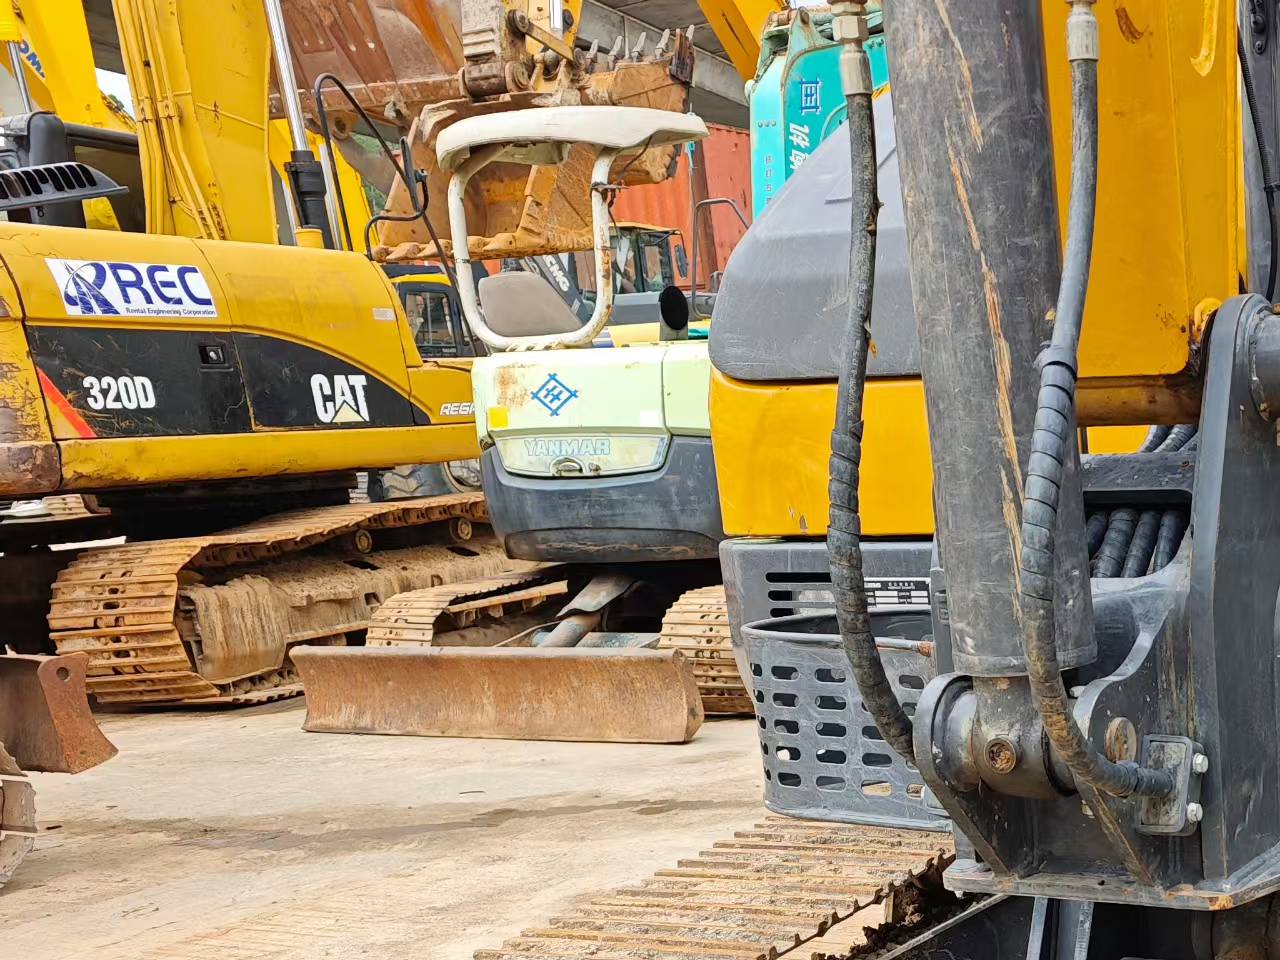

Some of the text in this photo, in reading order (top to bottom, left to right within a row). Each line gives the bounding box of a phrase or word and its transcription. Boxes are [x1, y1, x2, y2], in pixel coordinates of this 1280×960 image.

[182, 308, 216, 316] Corporation
[82, 373, 370, 423] 320D CAT
[523, 438, 611, 457] YANMAR
